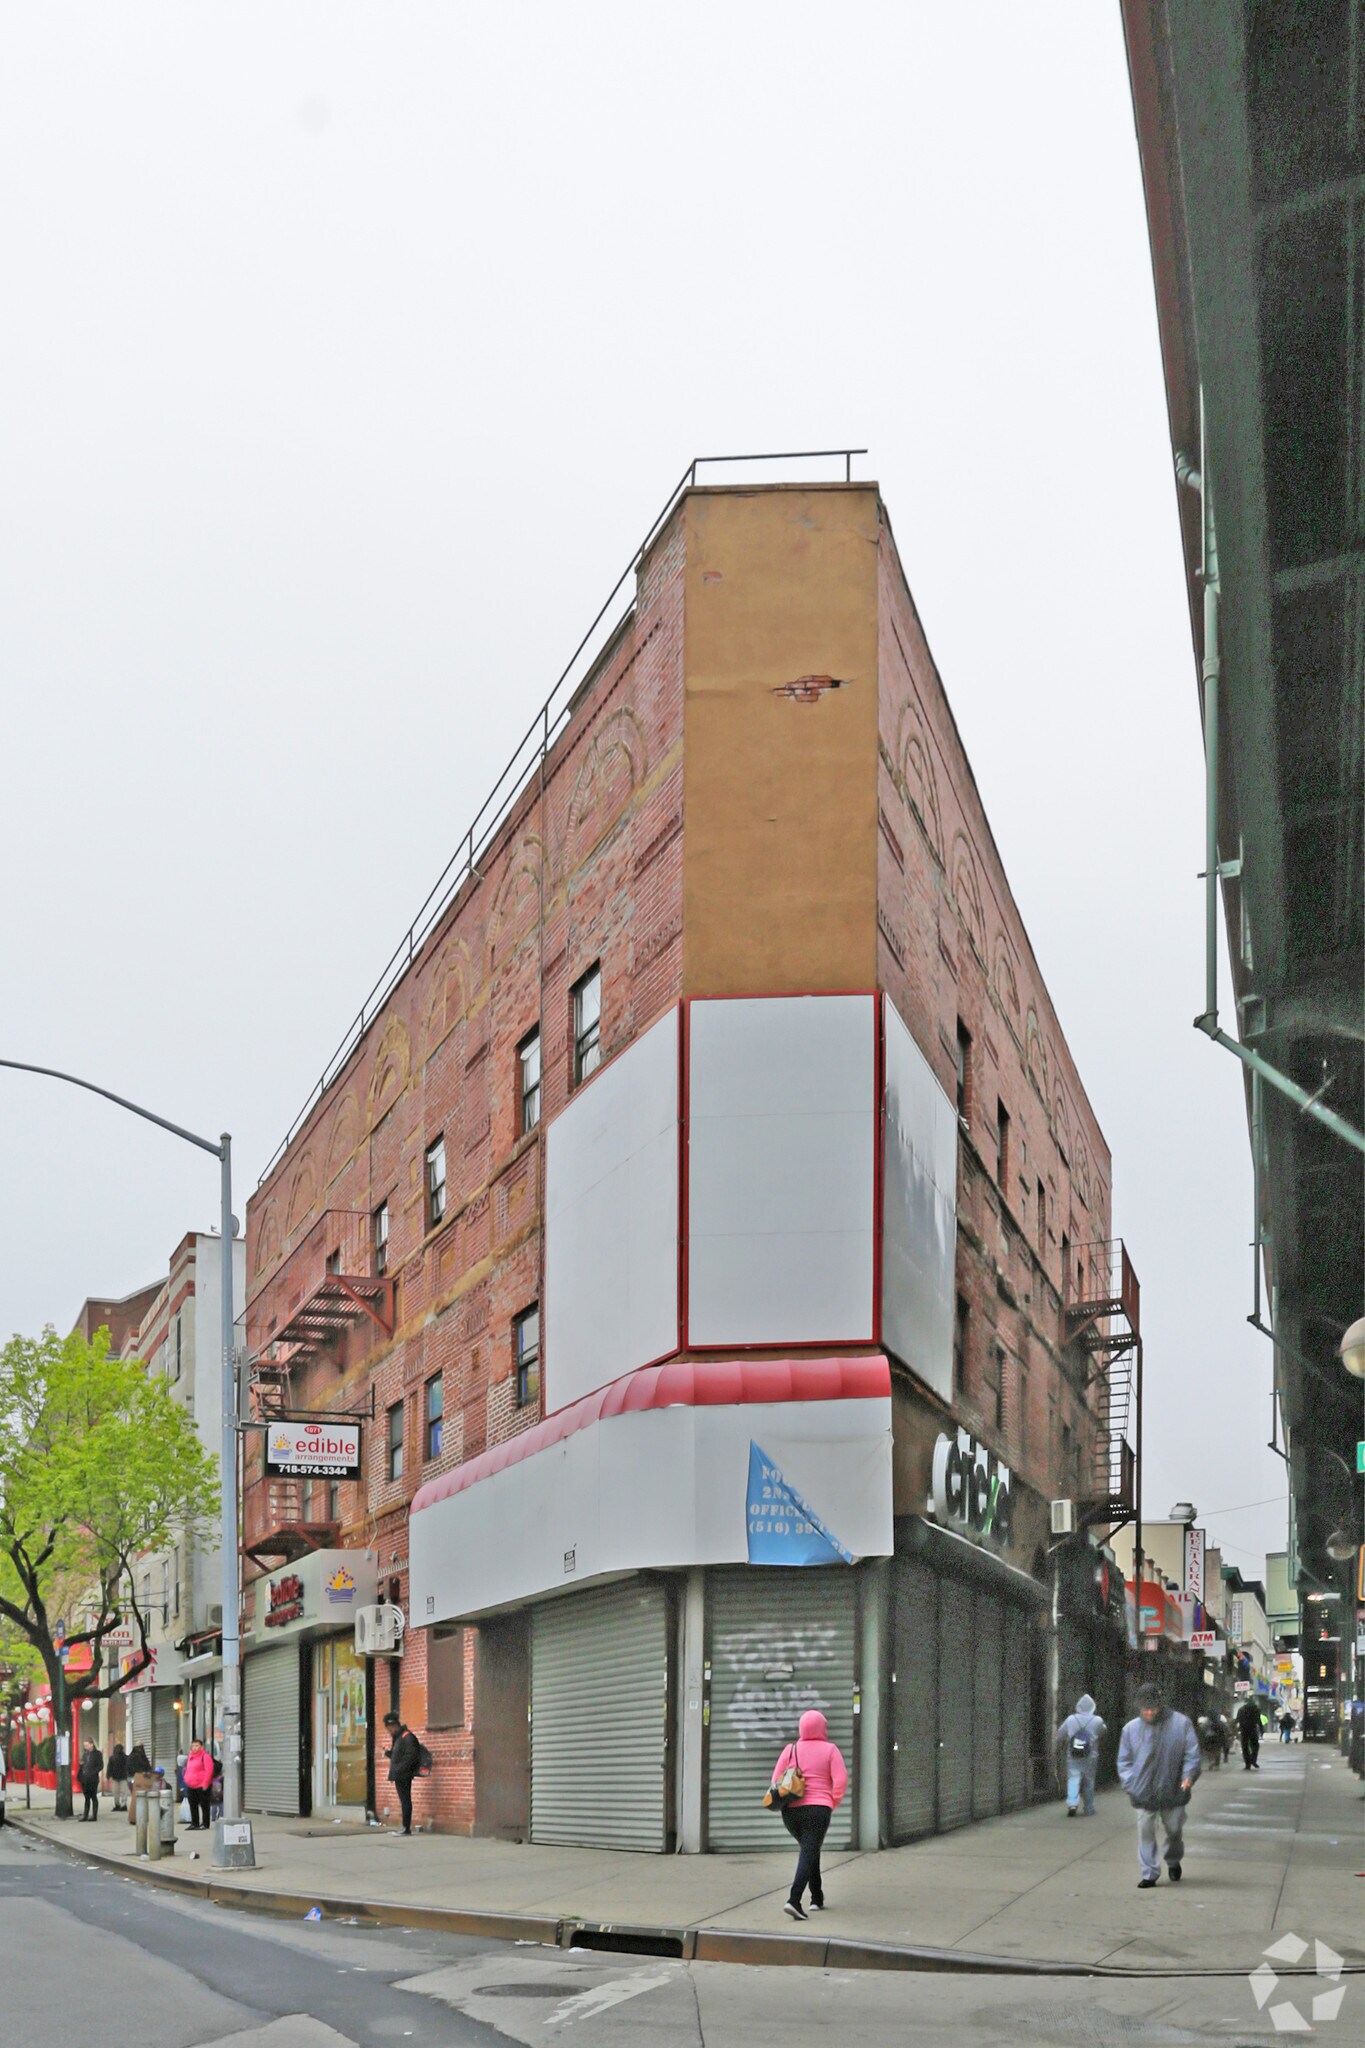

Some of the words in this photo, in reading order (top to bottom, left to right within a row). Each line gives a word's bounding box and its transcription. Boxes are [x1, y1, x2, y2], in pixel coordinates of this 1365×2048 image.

[295, 1438, 356, 1454] edible
[295, 1454, 355, 1463] arrangements
[278, 1464, 348, 1475] 718-574-3344
[1191, 1633, 1213, 1642] ATM
